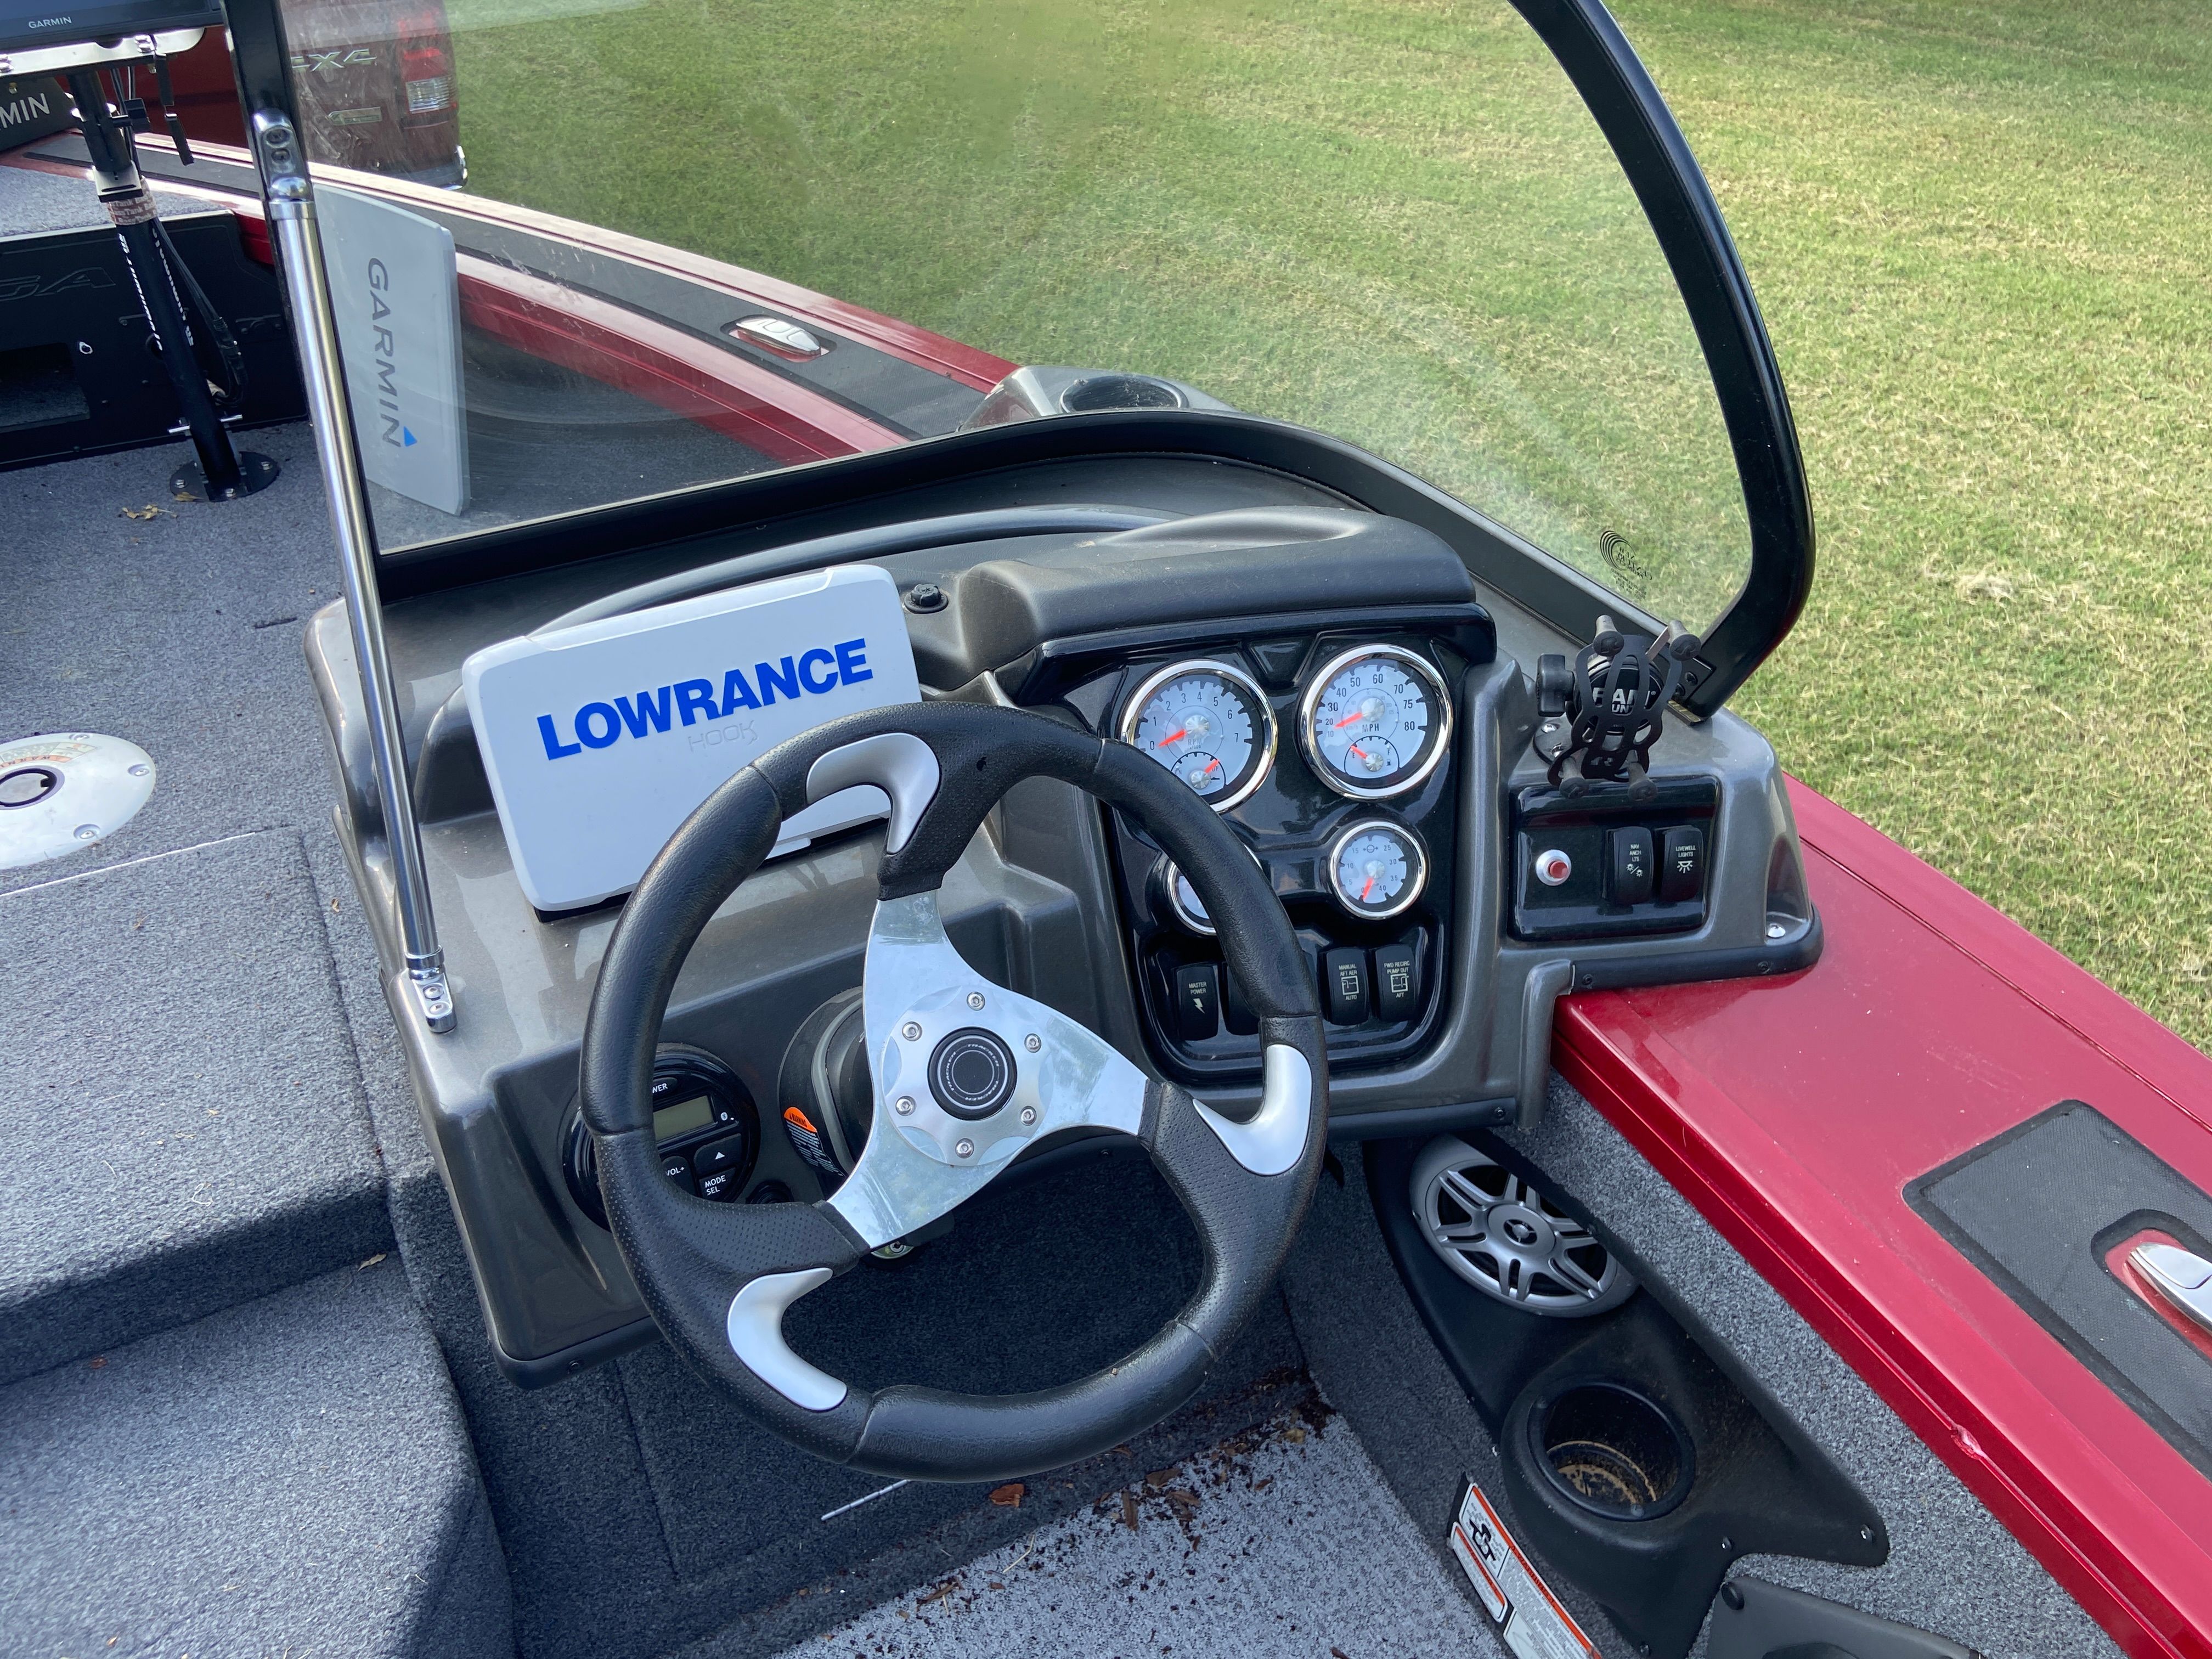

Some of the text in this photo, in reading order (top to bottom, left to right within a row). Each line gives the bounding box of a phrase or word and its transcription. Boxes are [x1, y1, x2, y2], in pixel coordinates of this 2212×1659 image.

[28, 16, 72, 29] GARMIN
[368, 257, 402, 448] GARMIN
[1350, 677, 1361, 687] 50
[1373, 673, 1383, 684] 60
[1336, 687, 1347, 697] 40
[1393, 684, 1403, 694] 70
[537, 637, 873, 761] LOWRANCE
[1181, 693, 1187, 703] 3
[1197, 691, 1202, 701] 4
[1166, 701, 1171, 711] 2
[1214, 697, 1218, 707] 5
[1328, 702, 1339, 712] 30
[1403, 699, 1413, 709] 75
[1227, 709, 1233, 720] 6
[1153, 716, 1157, 726] 1
[1404, 721, 1415, 731] 80
[1362, 723, 1379, 733] MPH
[688, 720, 758, 752] HOOK
[1234, 732, 1239, 743] 7
[1150, 741, 1155, 750] 0
[652, 1083, 668, 1093] WER
[704, 1175, 726, 1188] MODE
[706, 1186, 720, 1196] SEL
